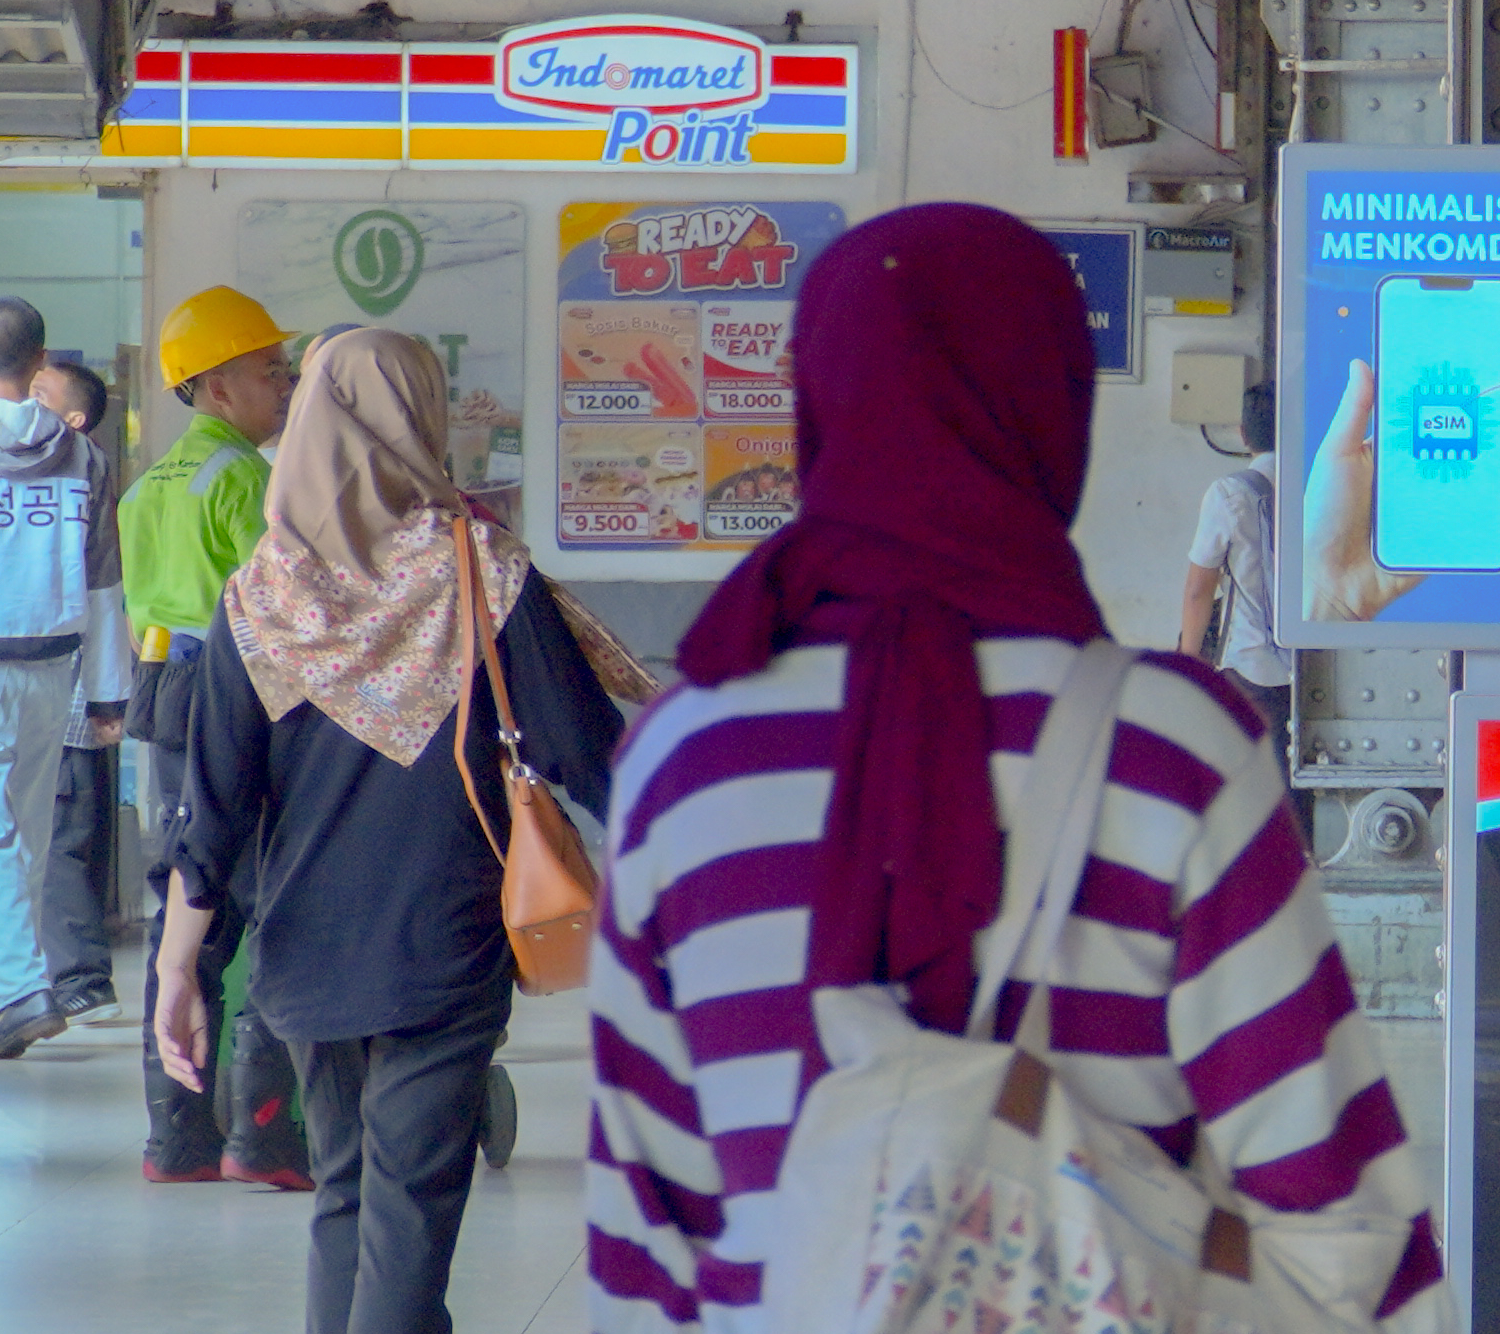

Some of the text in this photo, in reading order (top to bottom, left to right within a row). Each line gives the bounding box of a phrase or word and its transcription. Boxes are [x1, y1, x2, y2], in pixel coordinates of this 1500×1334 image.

[518, 46, 748, 90] Indomaret
[605, 110, 752, 165] Point
[637, 208, 757, 255] READY
[604, 245, 794, 293] TO EAT
[711, 323, 783, 337] READY
[711, 339, 777, 356] TO EAT
[577, 395, 640, 410] 12.000
[720, 393, 783, 408] 18.000
[1423, 415, 1466, 430] eSIM
[736, 436, 798, 456] Onigir
[574, 515, 638, 532] 9.500
[721, 516, 782, 531] 13.000
